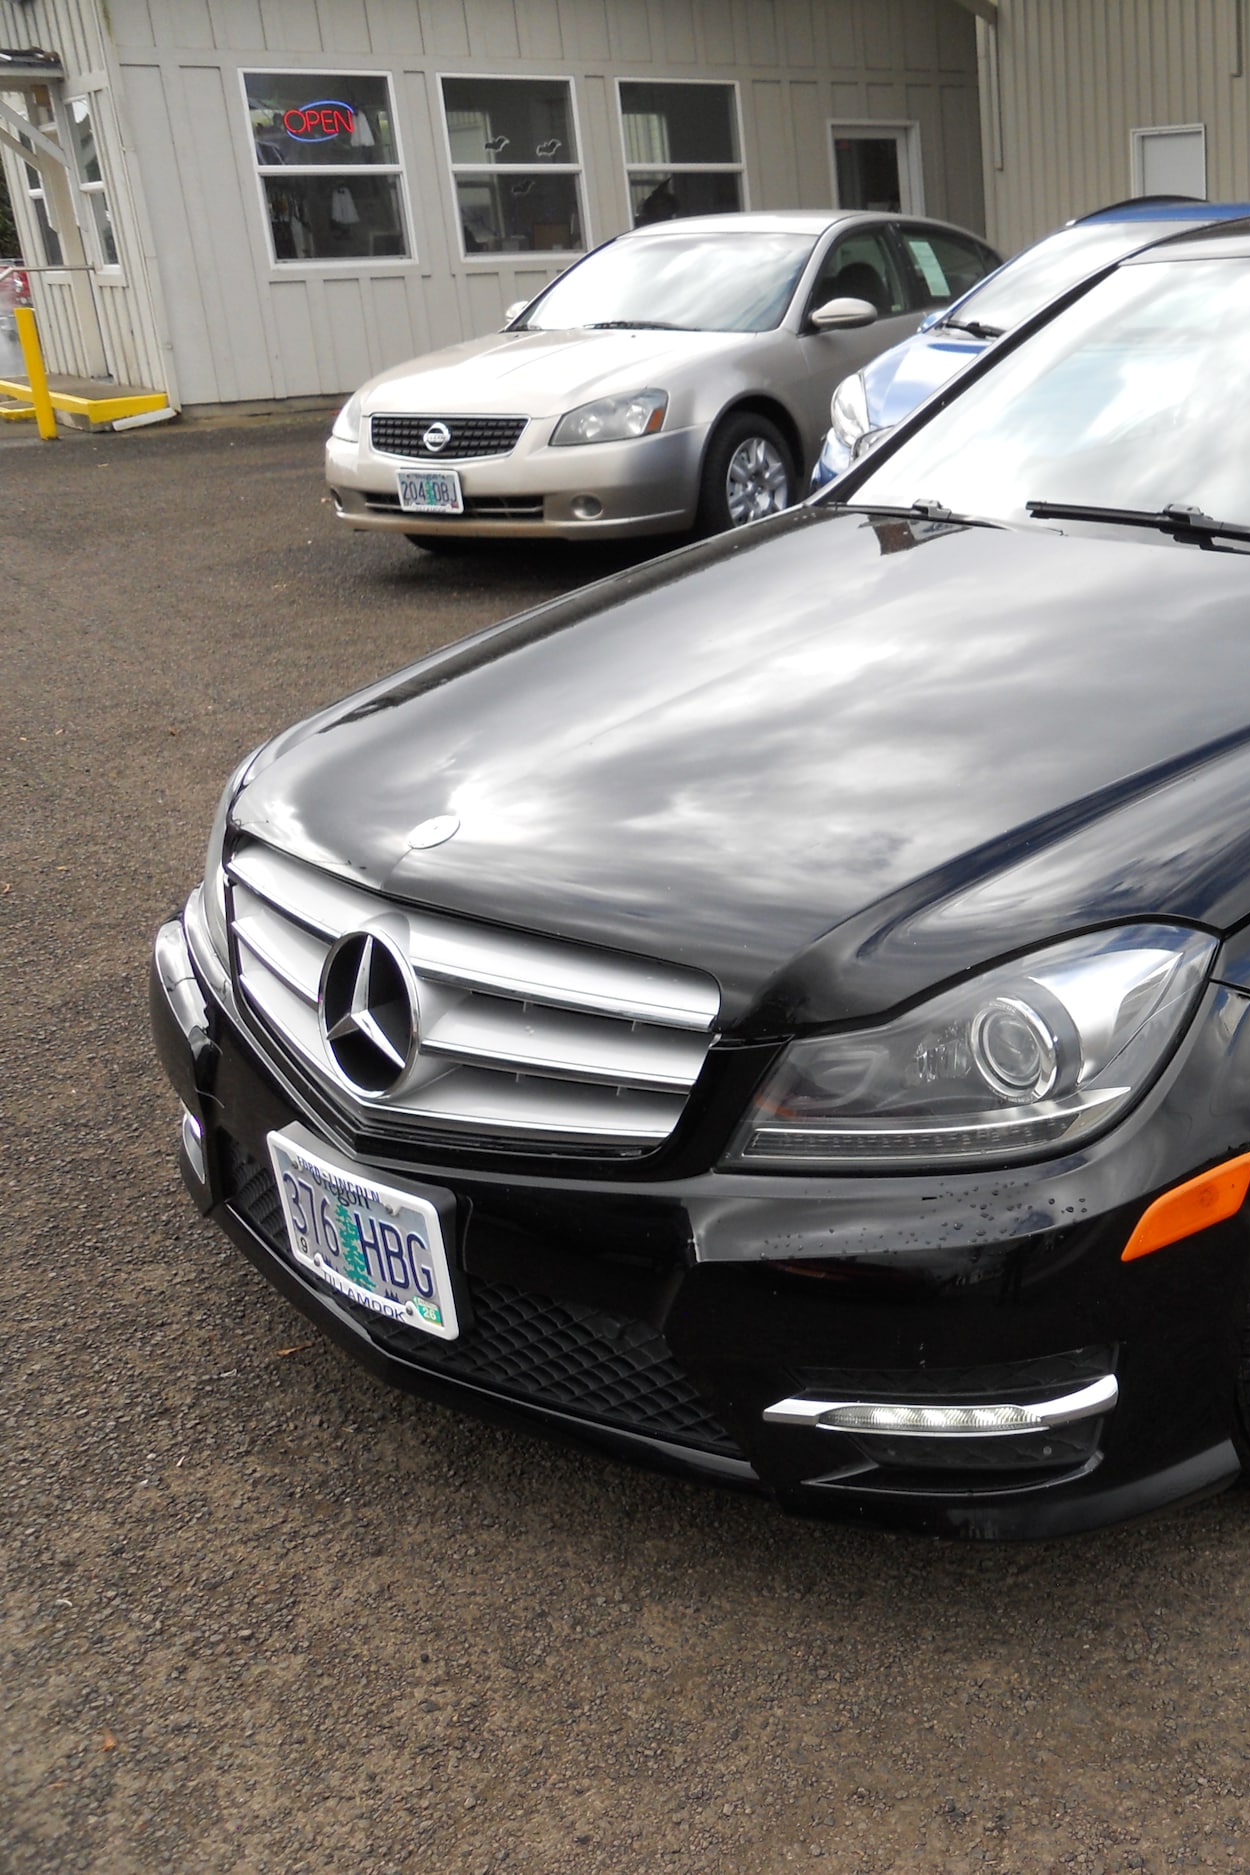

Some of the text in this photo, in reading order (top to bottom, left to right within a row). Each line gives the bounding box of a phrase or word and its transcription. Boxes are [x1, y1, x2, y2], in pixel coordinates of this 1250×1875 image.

[283, 109, 355, 134] OPEN
[401, 481, 426, 501] 204
[283, 1172, 434, 1298] 376 HBG
[322, 1270, 407, 1323] TILLAMOOK
